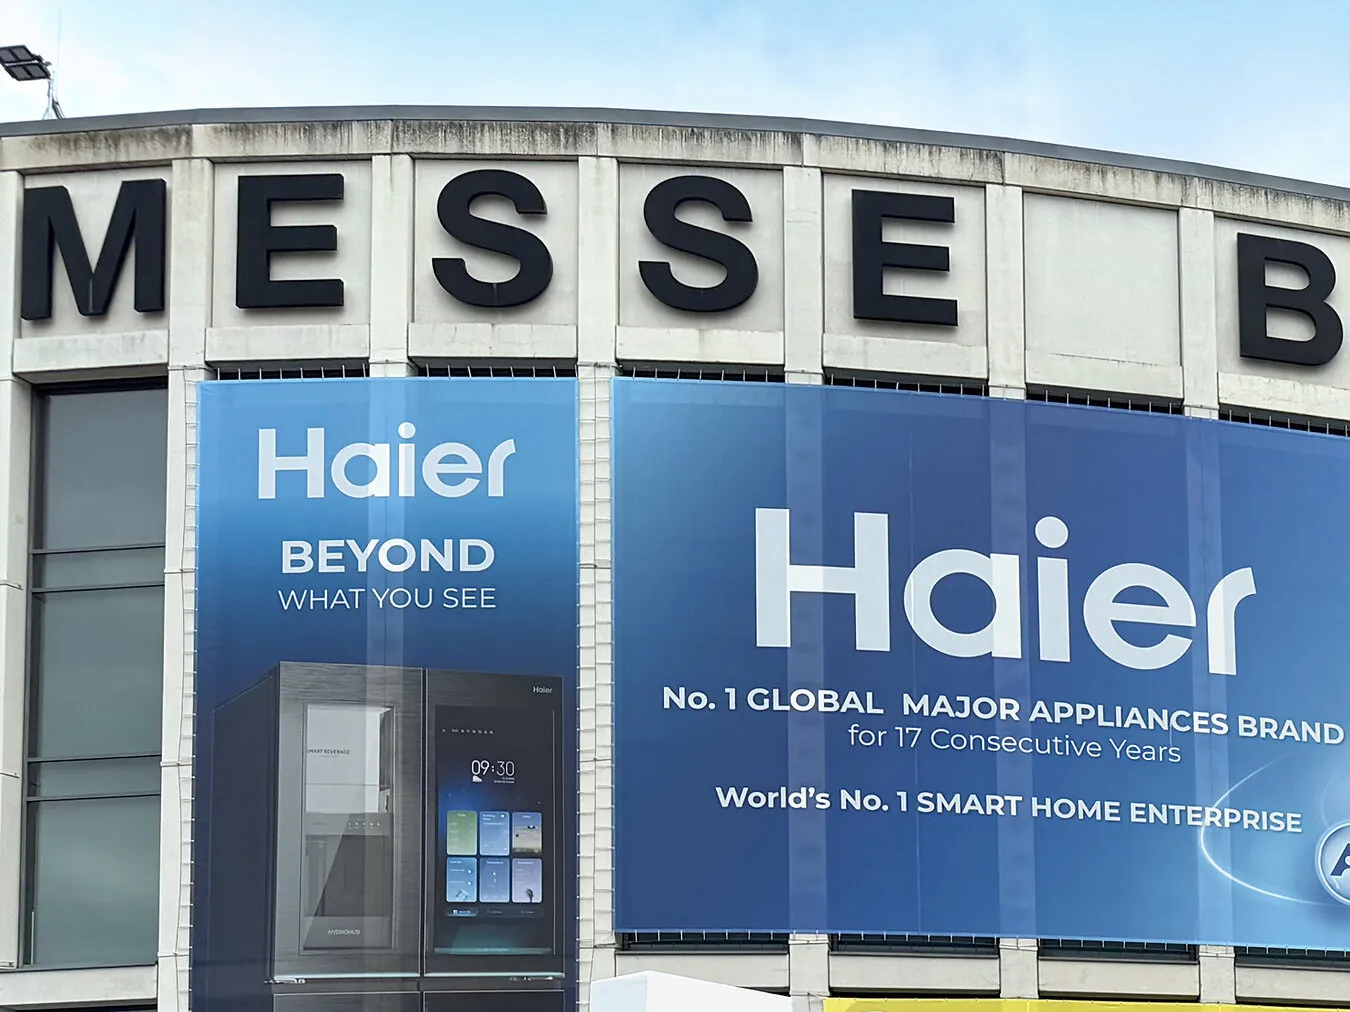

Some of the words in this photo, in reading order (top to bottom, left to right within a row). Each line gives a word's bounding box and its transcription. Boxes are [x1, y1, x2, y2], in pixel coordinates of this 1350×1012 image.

[20, 168, 959, 327] MESSE
[258, 422, 516, 499] Haier
[280, 539, 496, 573] BEYOND
[278, 589, 363, 611] WHAT
[371, 588, 433, 610] YOU
[441, 588, 496, 609] SEE
[755, 507, 1256, 676] Haier
[663, 686, 716, 710] No.
[724, 688, 736, 710] 1
[747, 688, 884, 714] GLOBAL
[903, 693, 1020, 721] MAJOR
[1029, 699, 1229, 735] APPLIANCES
[1238, 715, 1345, 745] BRAND
[848, 723, 887, 746] for
[895, 726, 922, 748] 17
[930, 728, 1101, 757] Consecutive
[1110, 738, 1181, 763] Years
[471, 760, 515, 776] 09:30
[715, 786, 831, 810] World's
[840, 788, 889, 811] No.
[896, 791, 907, 812] 1
[917, 791, 1022, 816] SMART
[1031, 796, 1121, 822] HOME
[1130, 801, 1303, 833] ENTERPRISE
